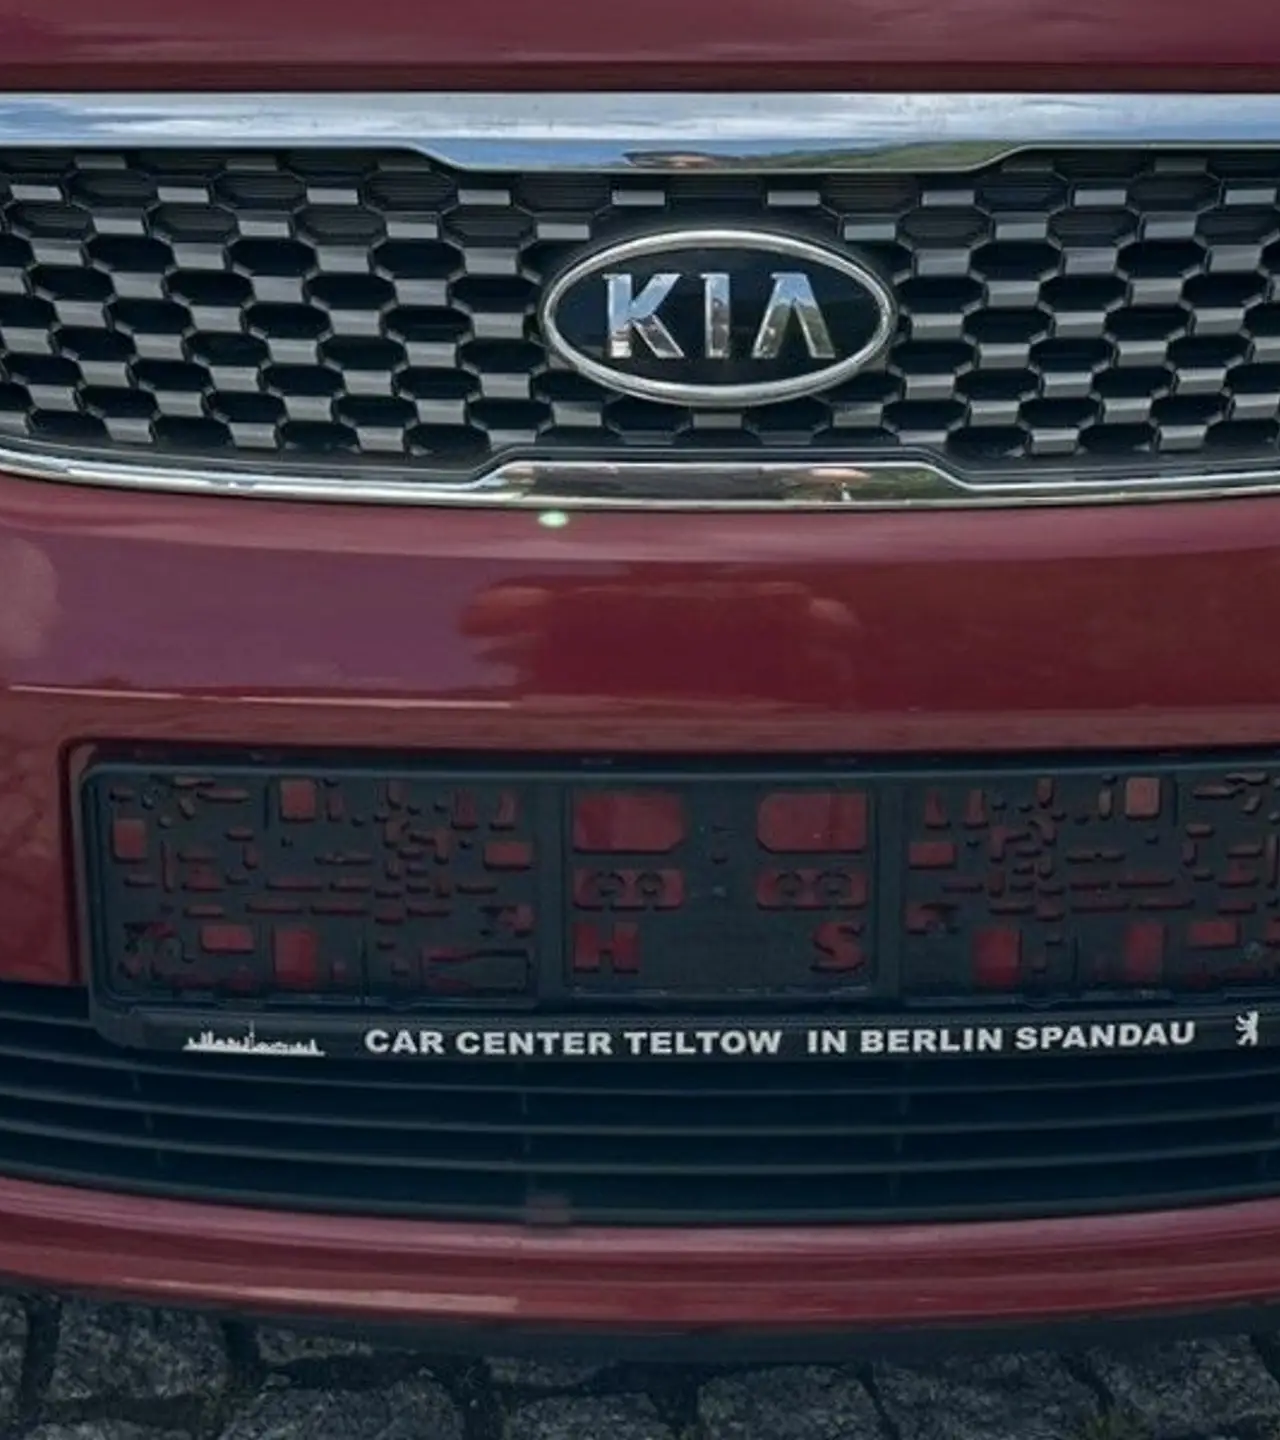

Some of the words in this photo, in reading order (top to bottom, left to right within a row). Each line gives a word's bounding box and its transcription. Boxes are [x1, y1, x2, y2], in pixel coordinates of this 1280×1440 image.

[601, 272, 836, 359] KIA
[364, 1028, 445, 1055] CAR
[455, 1030, 612, 1056] CENTER
[624, 1030, 783, 1056] TELTOW
[807, 1029, 847, 1054] IN
[860, 1027, 1003, 1054] BERLIN
[1015, 1020, 1195, 1050] SPANDAU
